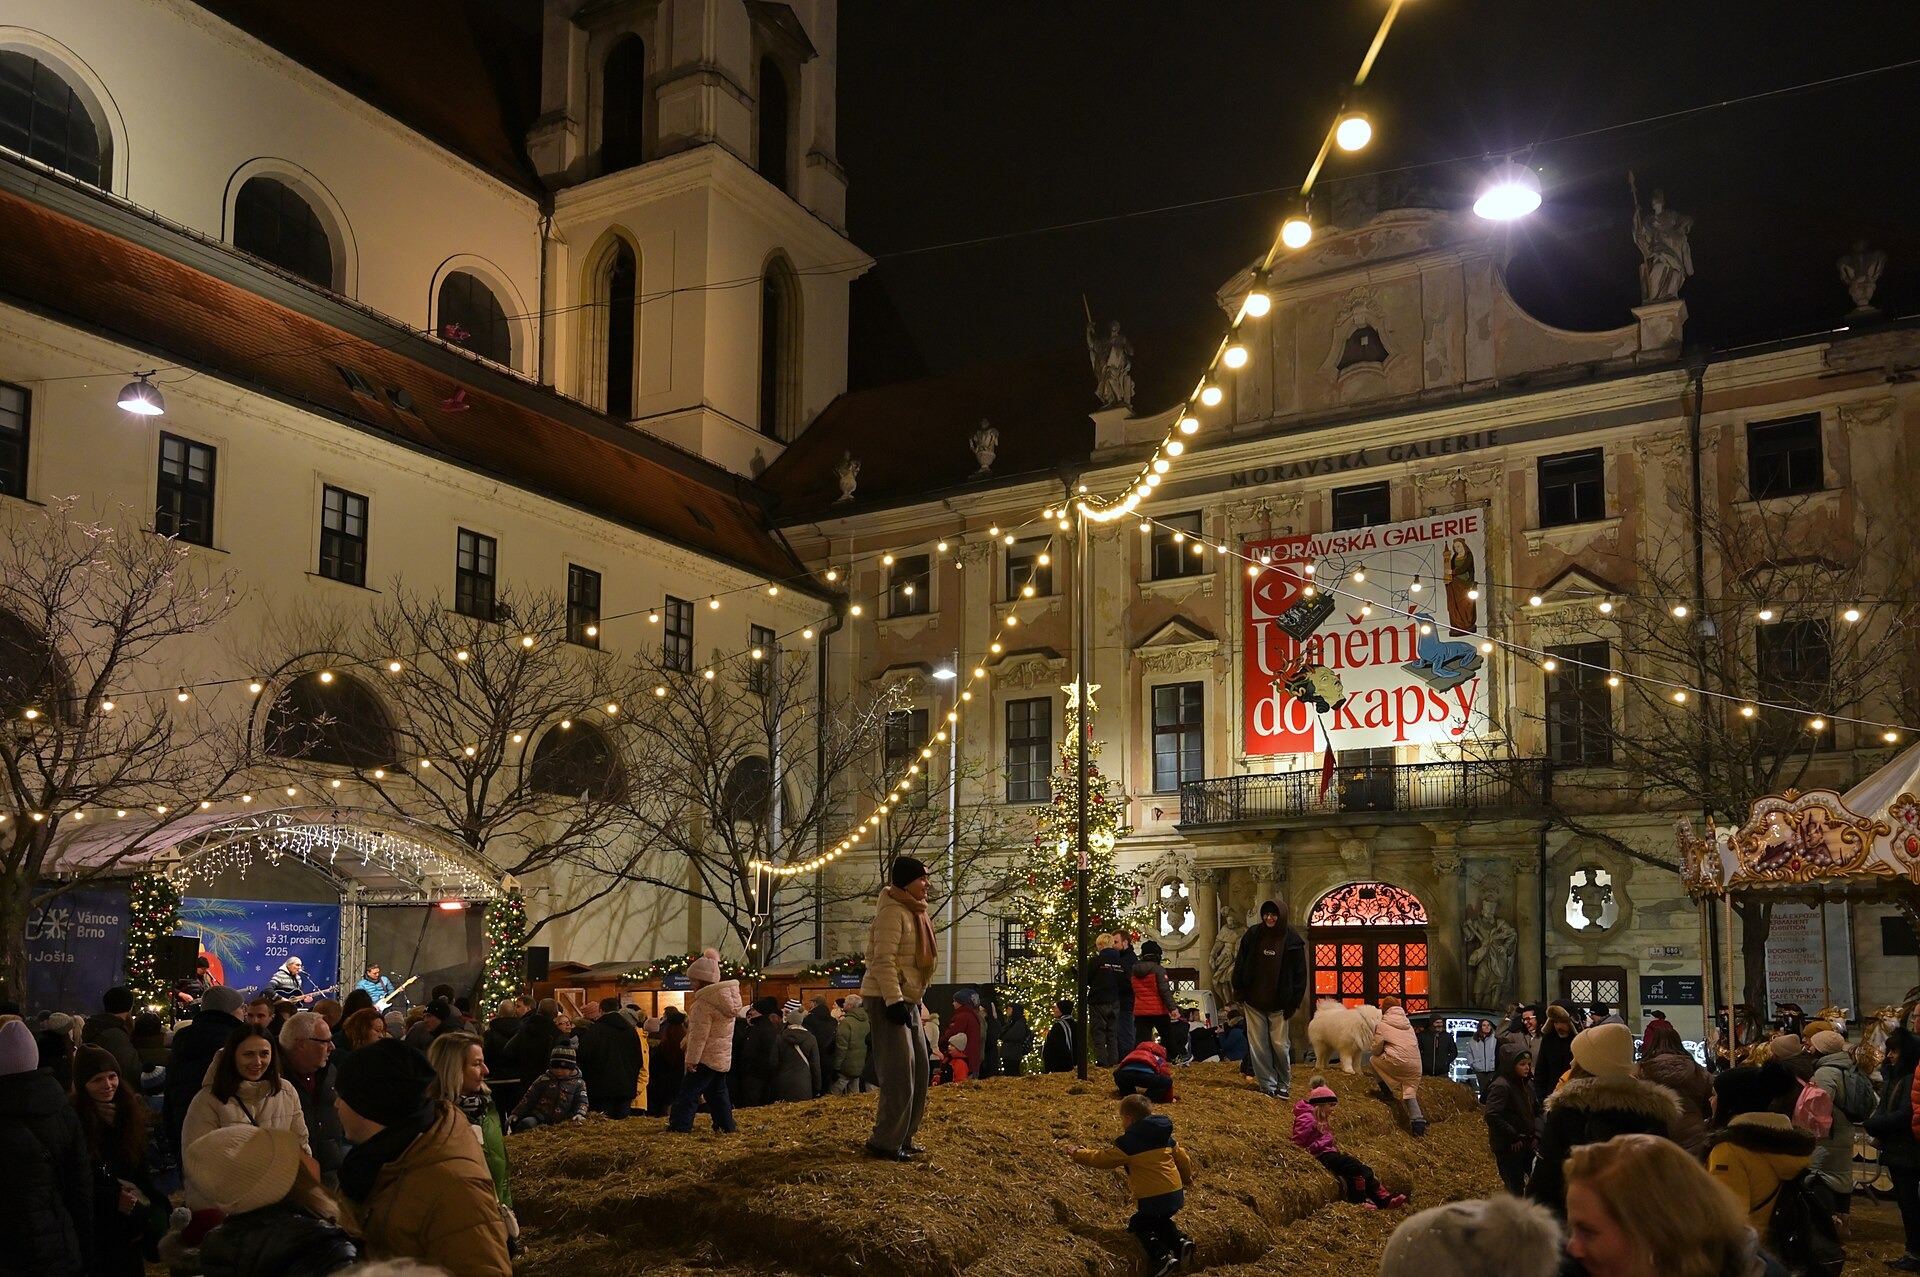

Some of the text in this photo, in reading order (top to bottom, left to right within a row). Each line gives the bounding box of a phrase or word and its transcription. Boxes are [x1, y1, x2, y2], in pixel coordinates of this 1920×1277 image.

[1230, 430, 1499, 487] MORAVSKÁ GALERIE
[1251, 515, 1478, 563] MORAVSKÁ GALERIE
[1330, 673, 1481, 742] kapsy
[77, 911, 119, 925] Vánoce
[77, 926, 105, 938] Brno
[266, 922, 320, 933] 14. listopadu
[266, 934, 326, 946] až 31. prosince
[34, 950, 75, 963] Jošta
[265, 946, 288, 956] 2025
